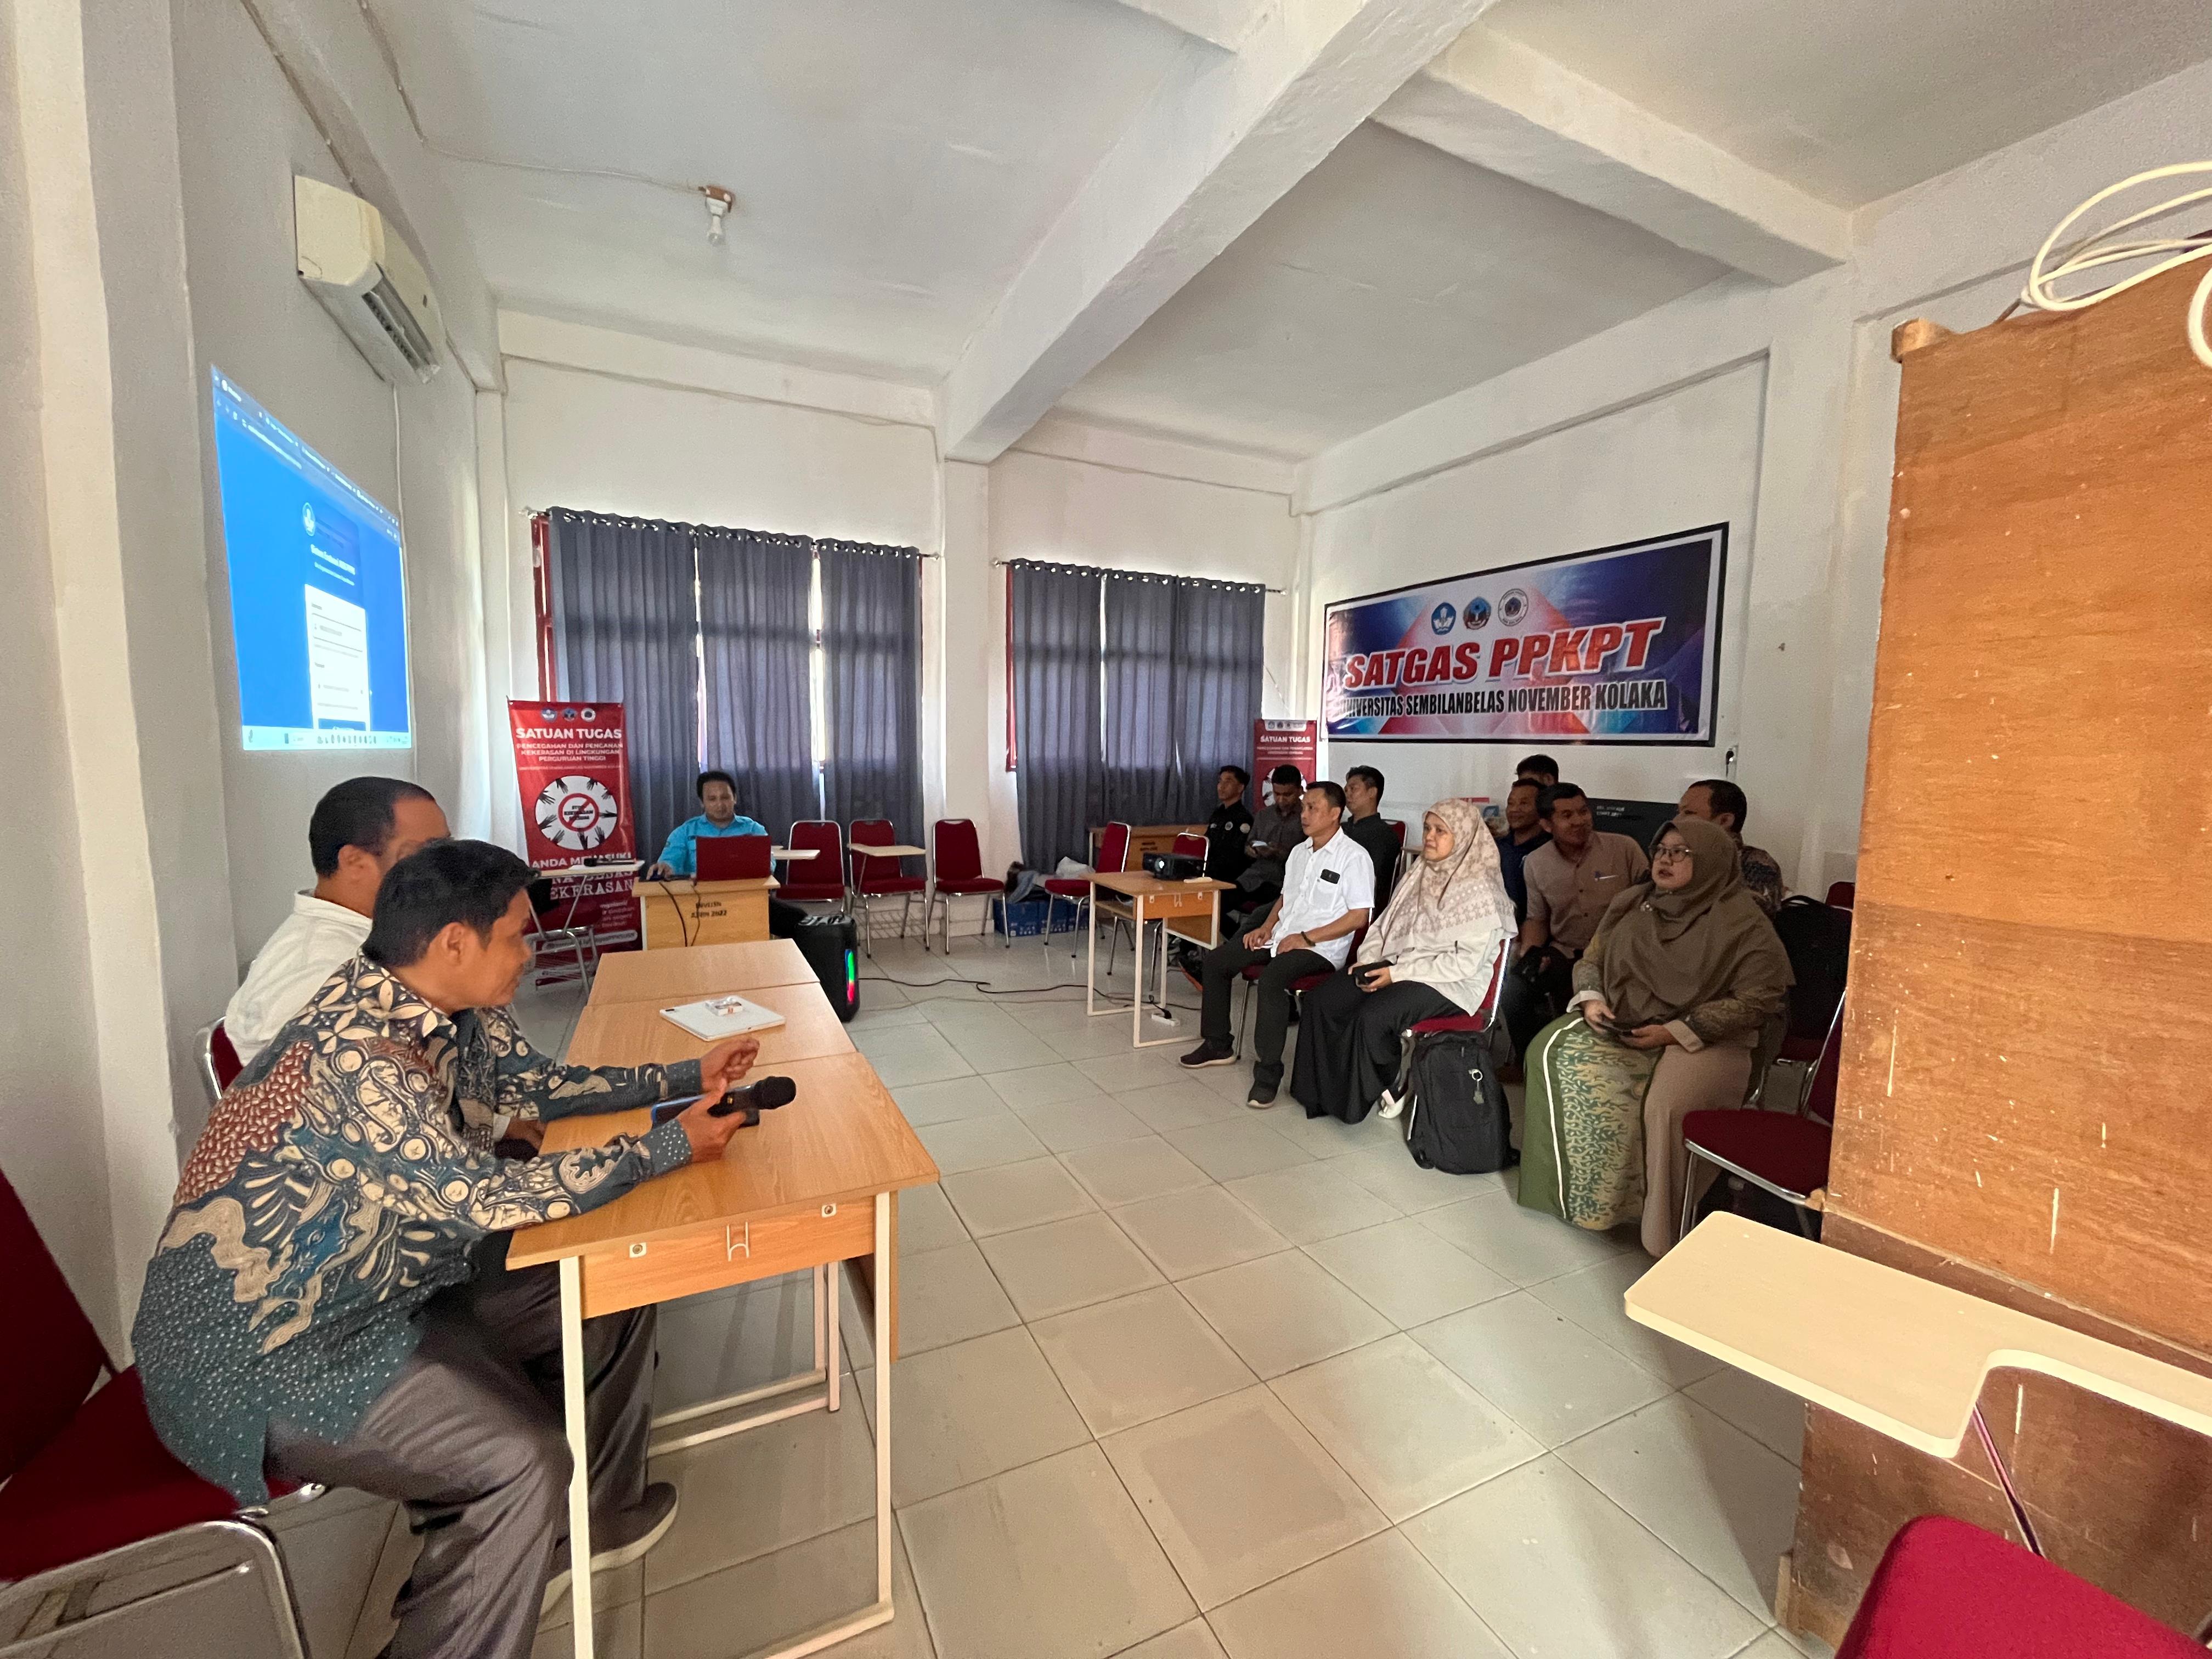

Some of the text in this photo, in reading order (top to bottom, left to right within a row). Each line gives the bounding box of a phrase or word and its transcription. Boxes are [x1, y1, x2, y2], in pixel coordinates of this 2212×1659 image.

[1344, 619, 1664, 690] SATGAS PPKPT
[1405, 689, 1505, 716] SEMBILANBELAS
[1508, 685, 1592, 713] NOVEMBER
[1595, 681, 1666, 710] KOLAKA
[516, 727, 622, 739] SATUAN TUGAS
[532, 852, 631, 868] ANDA MESUKI
[550, 879, 633, 900] EKERASAN
